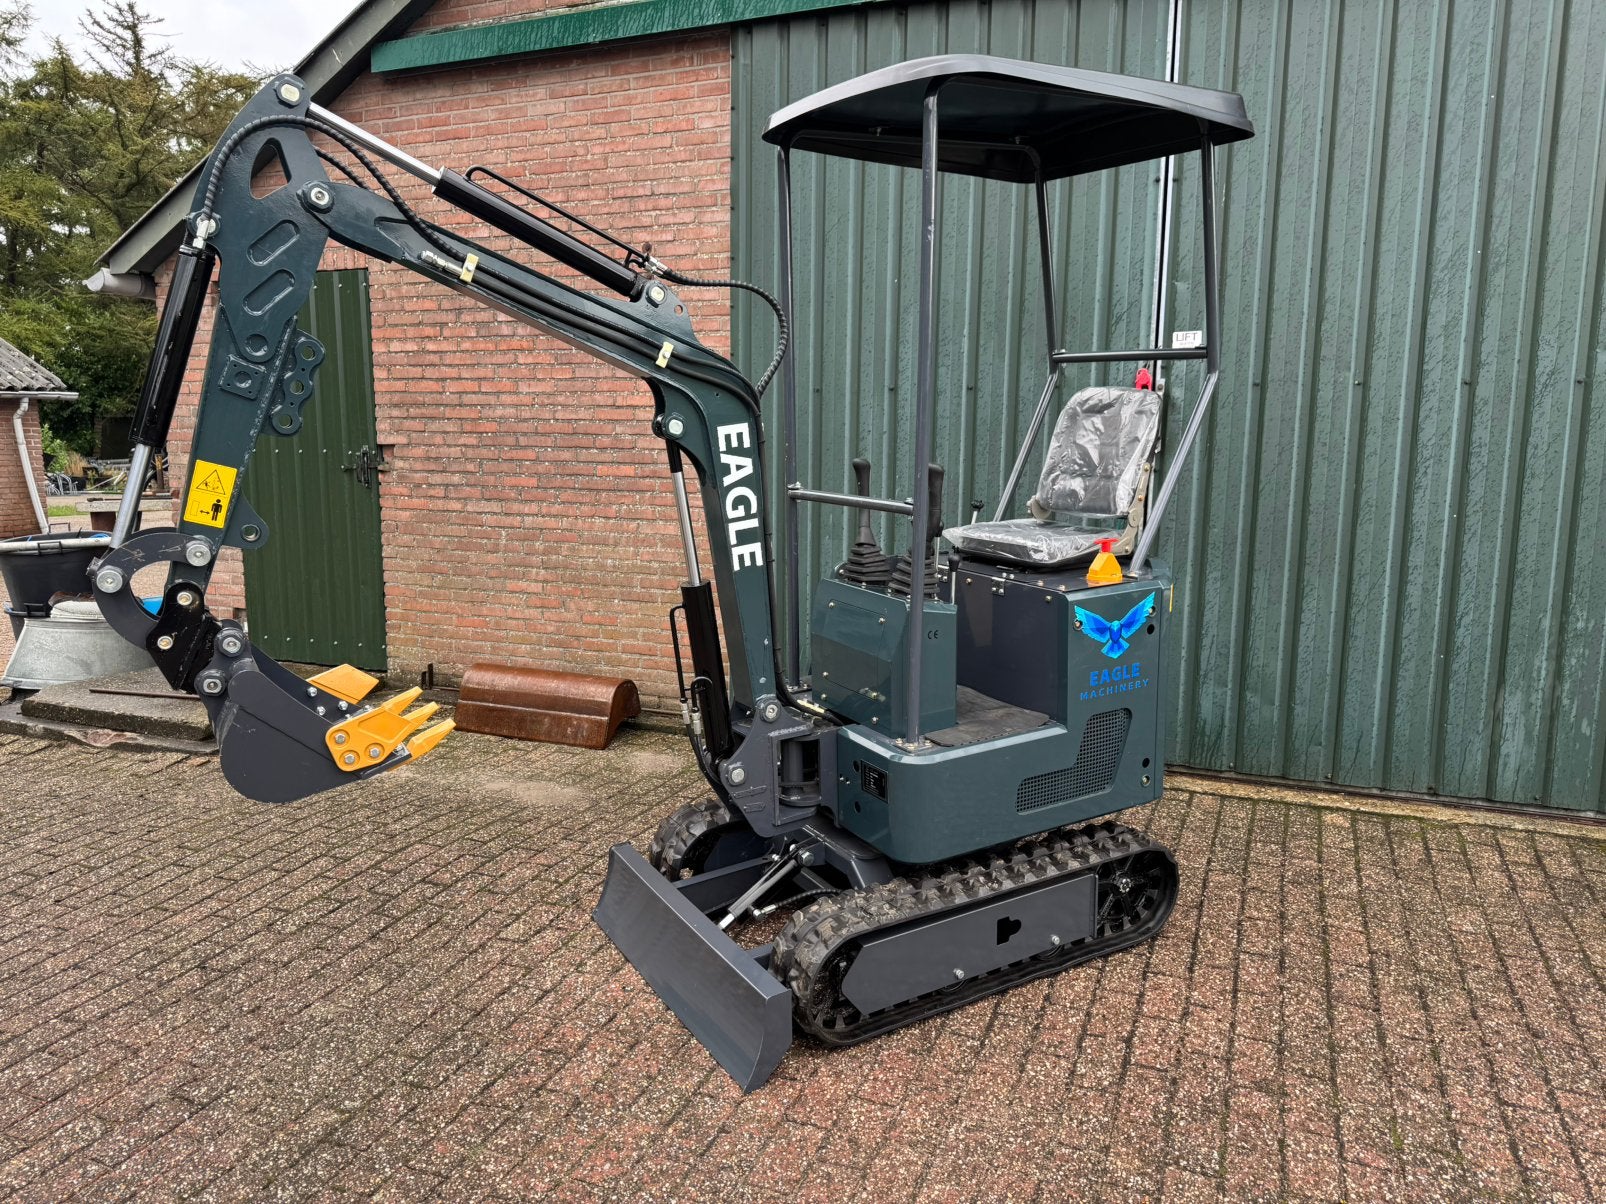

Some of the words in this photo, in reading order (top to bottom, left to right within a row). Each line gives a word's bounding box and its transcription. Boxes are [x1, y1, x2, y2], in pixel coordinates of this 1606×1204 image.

[1176, 332, 1198, 342] LIFT
[716, 422, 764, 572] EAGLE
[1089, 662, 1142, 687] EAGLE
[1079, 678, 1150, 701] MACHINERY
